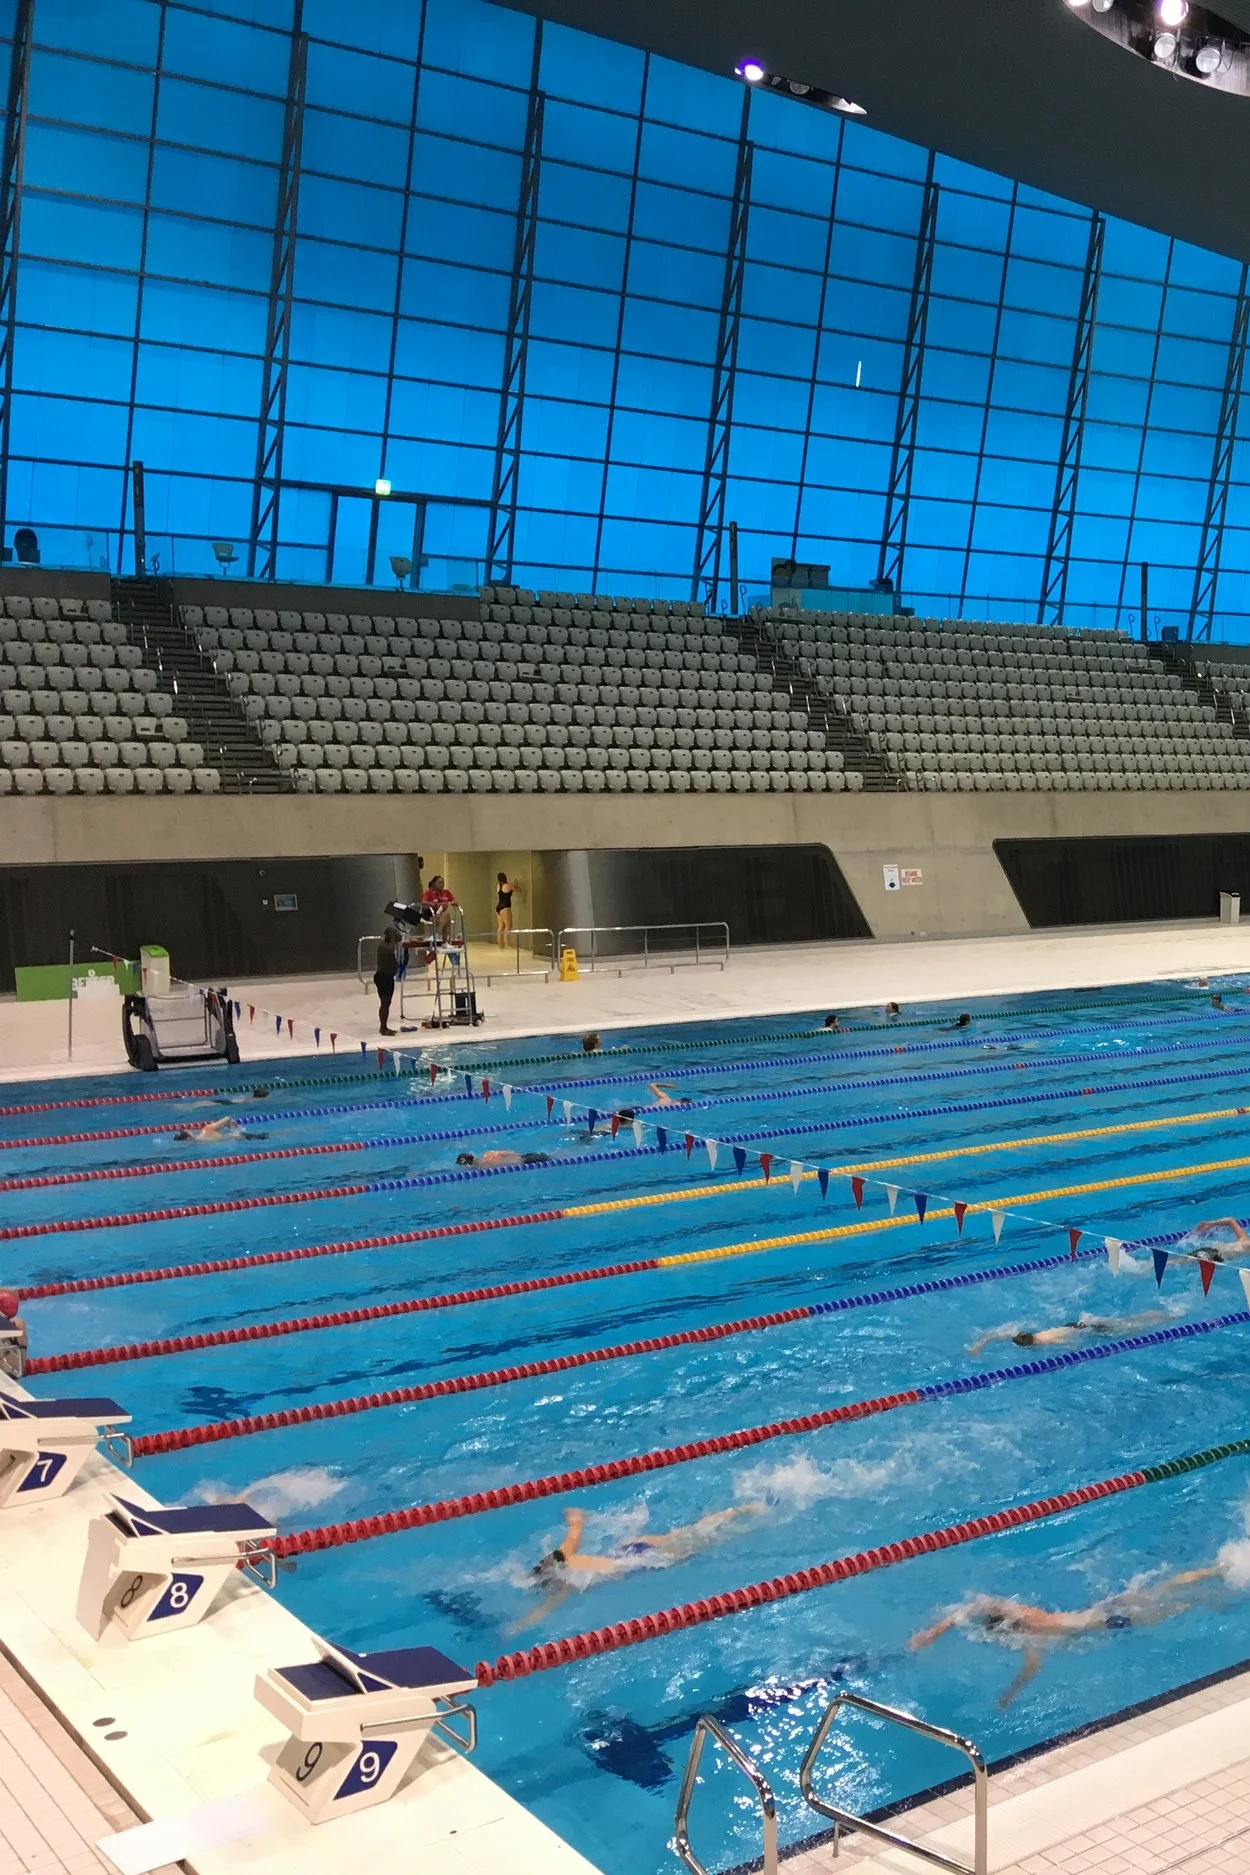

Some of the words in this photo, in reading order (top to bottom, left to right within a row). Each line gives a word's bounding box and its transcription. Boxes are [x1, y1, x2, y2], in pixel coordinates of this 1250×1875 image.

[37, 1458, 54, 1483] 7
[120, 1574, 143, 1609] 8
[169, 1582, 189, 1609] 8
[296, 1741, 323, 1782] 9
[359, 1751, 380, 1783] 9
